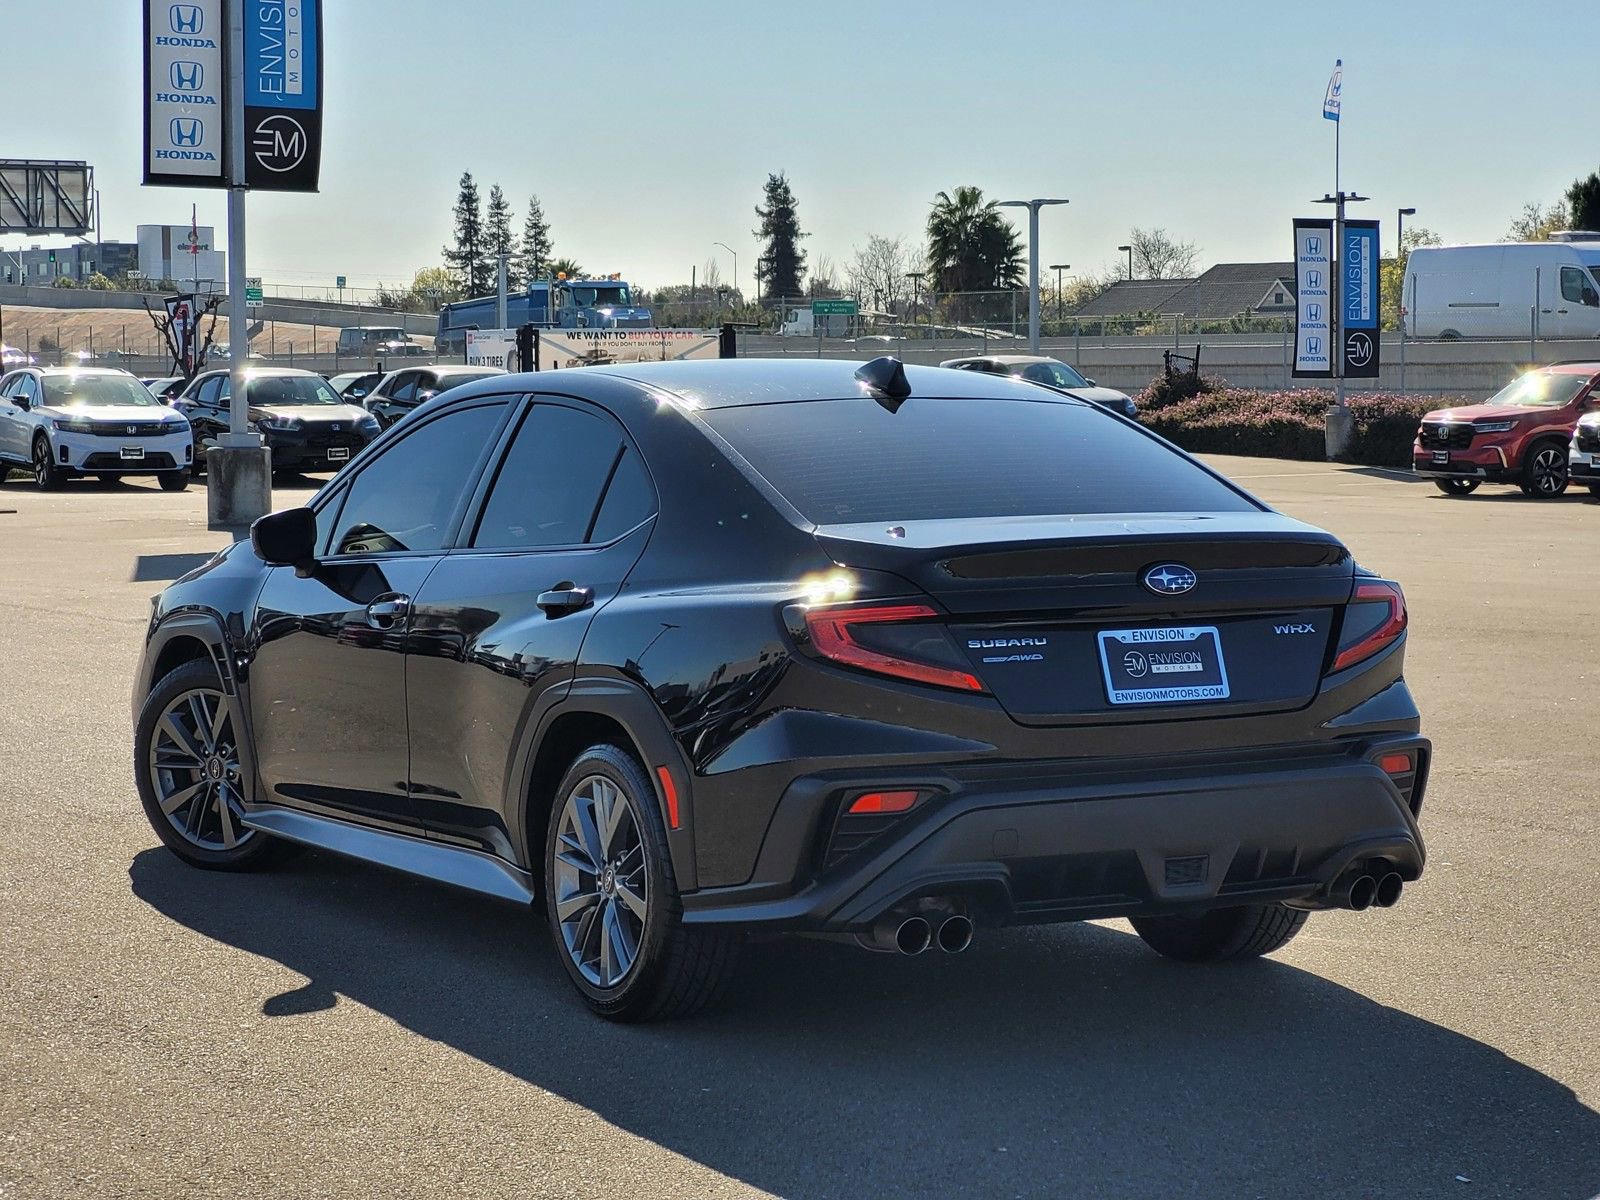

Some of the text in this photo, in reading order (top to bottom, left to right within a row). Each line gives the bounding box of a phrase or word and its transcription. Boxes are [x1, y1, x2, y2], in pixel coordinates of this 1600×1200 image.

[155, 36, 217, 48] HONDA
[155, 93, 217, 105] HONDA
[155, 150, 217, 161] HONDA
[1349, 236, 1361, 321] ENVISION
[566, 331, 694, 340] WE WANT TO BUY YOUR CAR
[482, 356, 486, 366] 3
[486, 355, 503, 367] TIRES
[1272, 623, 1316, 634] WRX
[1132, 629, 1185, 641] ENVISION
[967, 637, 1047, 648] SUBARU
[1007, 654, 1043, 662] AWD
[1148, 651, 1201, 665] ENVISION
[1115, 687, 1224, 702] ENVISIONMOTORS.COM
